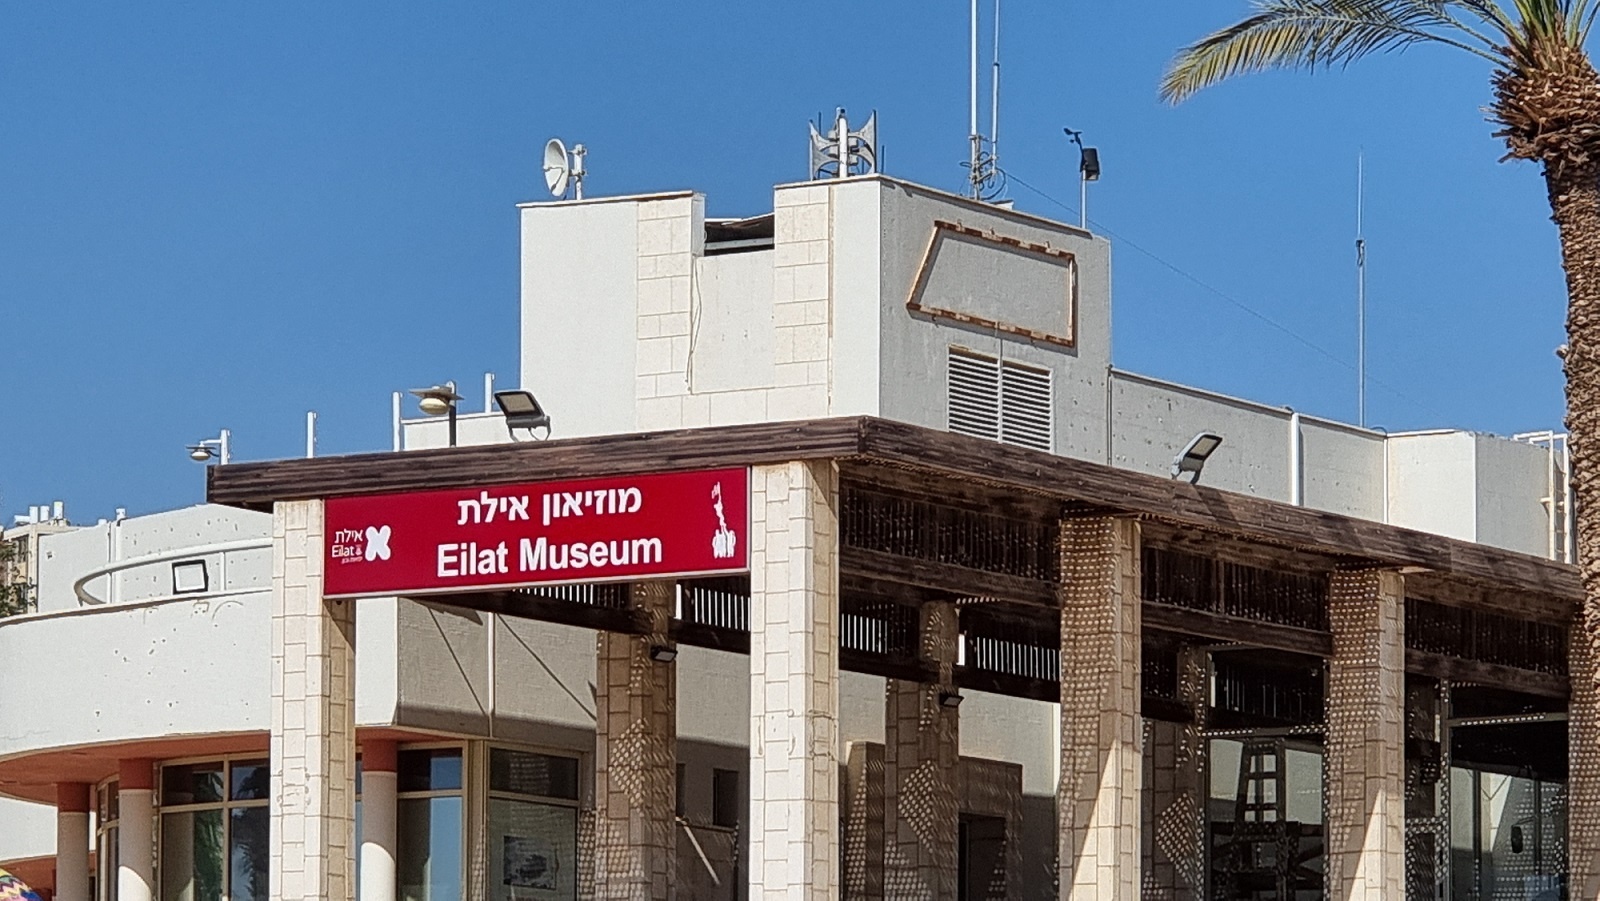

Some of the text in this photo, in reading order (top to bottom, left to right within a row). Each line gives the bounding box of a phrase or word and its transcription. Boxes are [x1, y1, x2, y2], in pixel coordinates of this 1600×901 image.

[457, 486, 642, 526] מוזיאון אילת
[334, 528, 364, 544] אילת
[331, 544, 355, 558] Eilat
[437, 536, 663, 578] Eilat Museum
